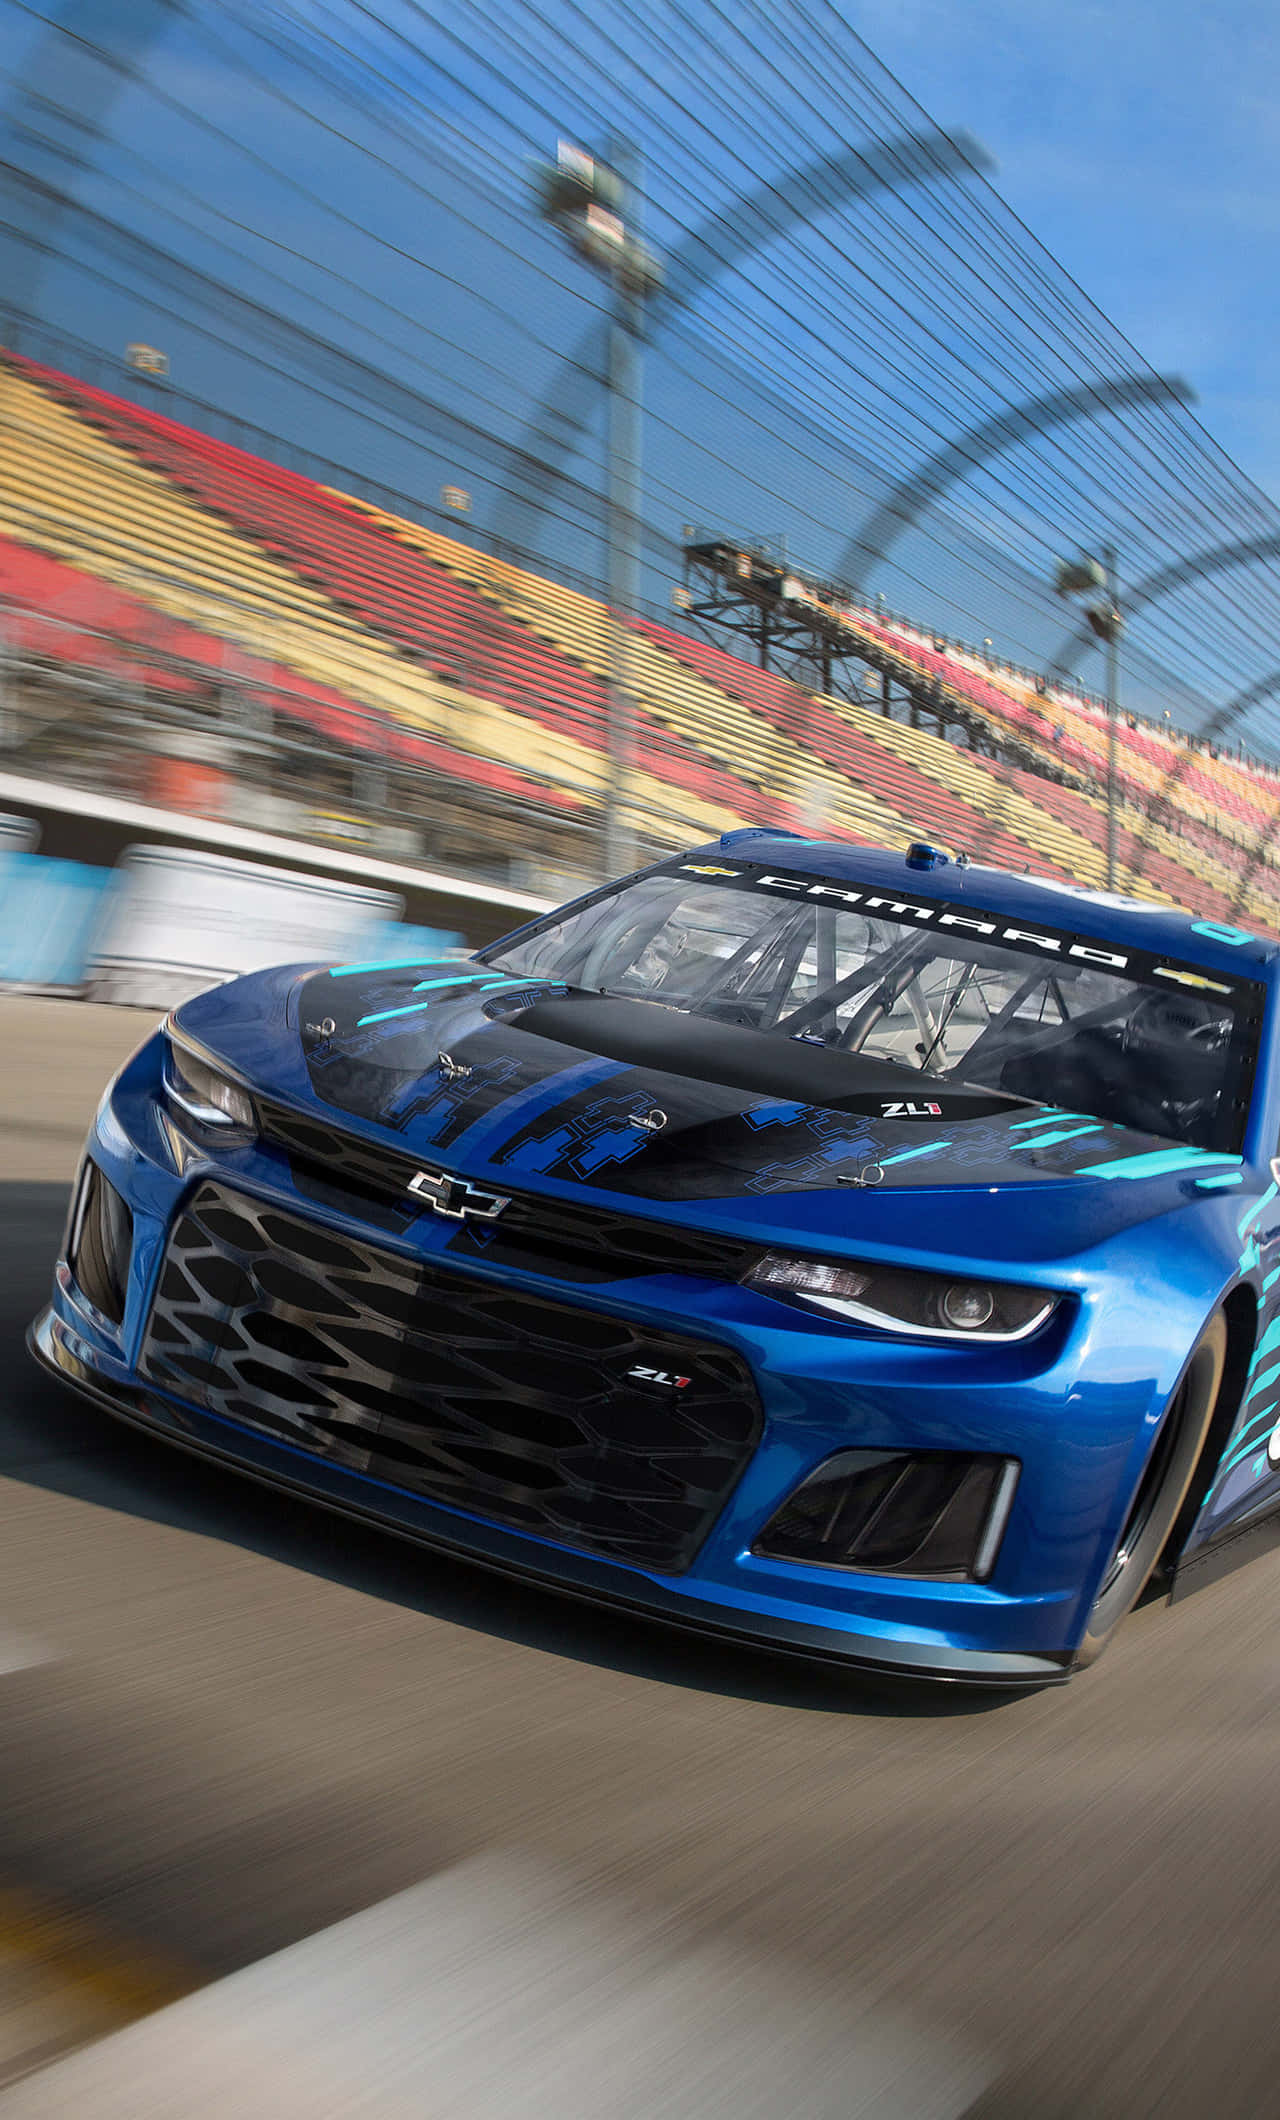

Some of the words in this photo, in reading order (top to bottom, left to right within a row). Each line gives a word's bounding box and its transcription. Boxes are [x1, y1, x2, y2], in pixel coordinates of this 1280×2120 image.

[756, 875, 1128, 968] CAMARO
[881, 1102, 942, 1117] ZL1
[628, 1366, 691, 1388] ZL1
